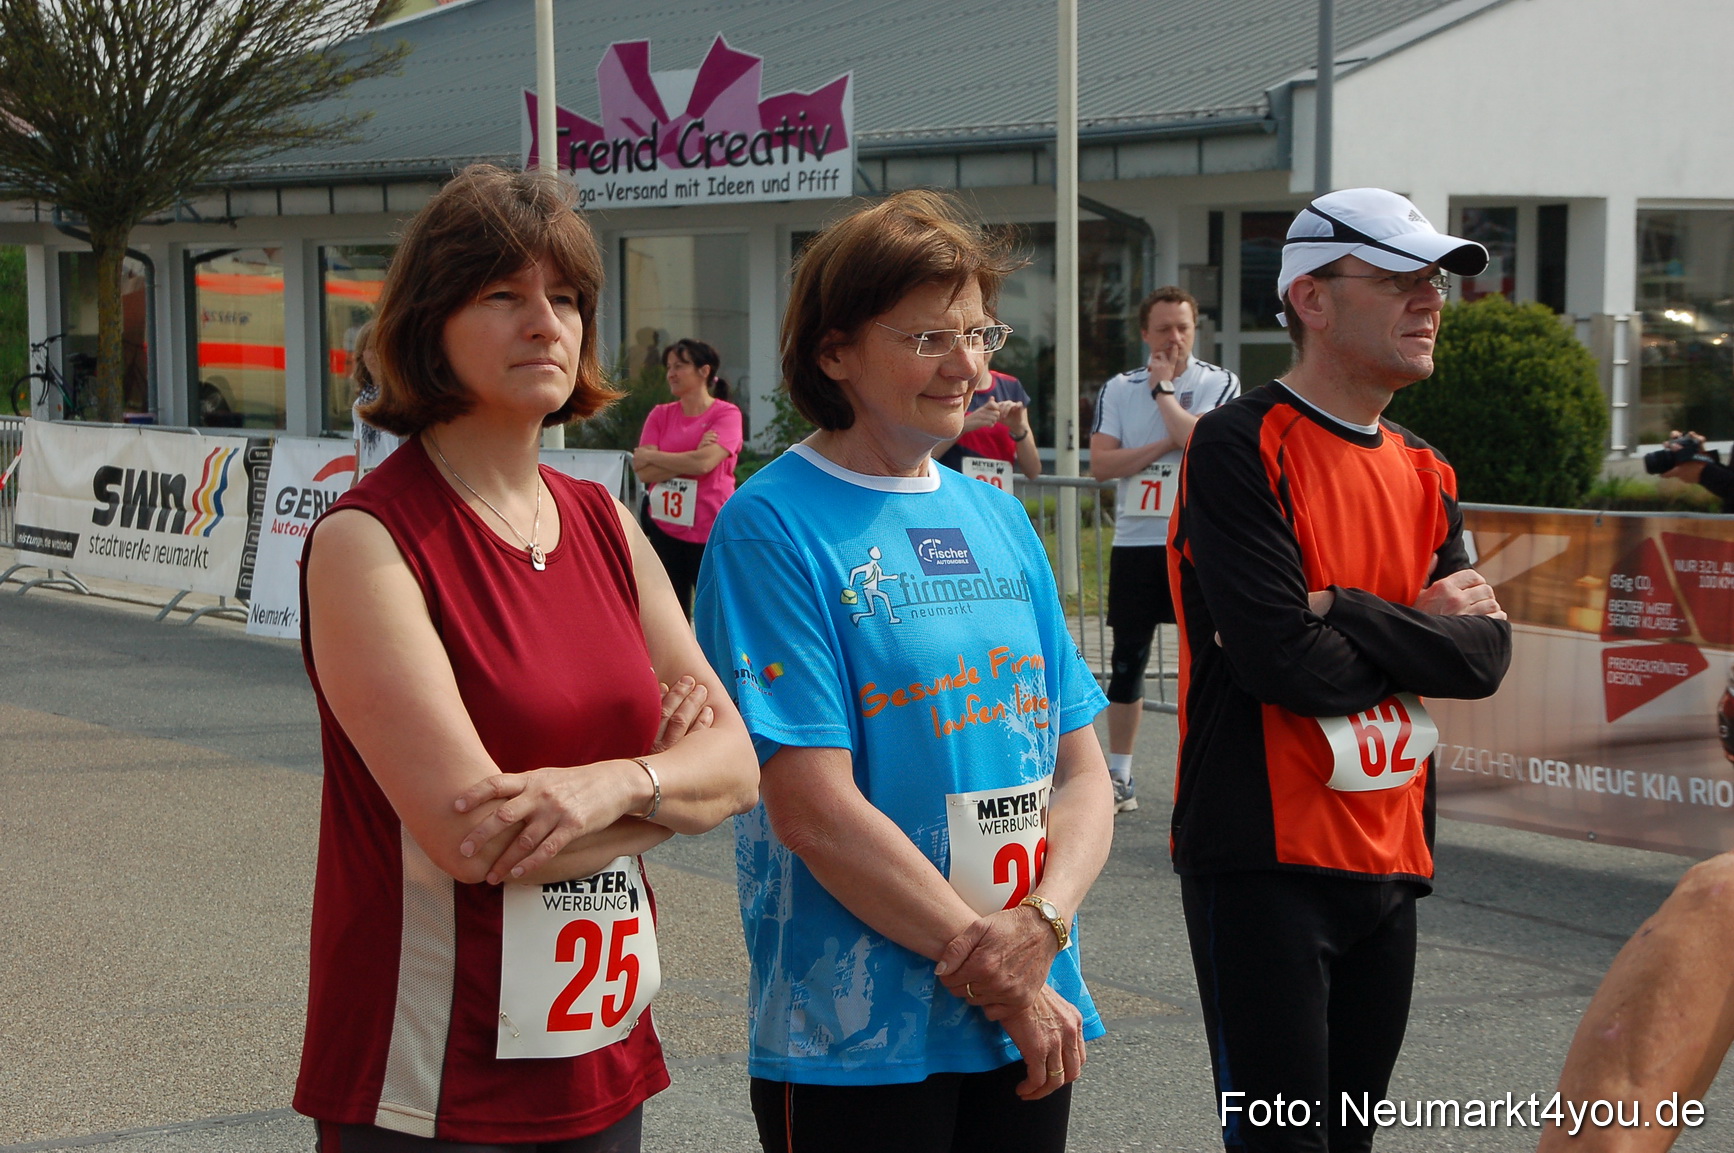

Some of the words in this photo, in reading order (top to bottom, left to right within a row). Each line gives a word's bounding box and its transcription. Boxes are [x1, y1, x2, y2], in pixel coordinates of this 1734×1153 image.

[678, 111, 832, 169] Creativ
[675, 178, 700, 198] mit
[708, 175, 755, 196] Ideen
[762, 172, 790, 194] und
[799, 168, 839, 192] Pfiff
[661, 490, 683, 518] 13
[1140, 480, 1163, 511] 71
[88, 534, 151, 562] stadtwerke
[152, 544, 209, 569] neumarkt
[928, 547, 968, 559] Fischer
[899, 567, 1030, 605] firmenlauf
[910, 603, 973, 619] neumarkt
[859, 654, 981, 718] Gesunde
[930, 693, 1007, 740] laufen
[1346, 695, 1416, 777] 62
[1528, 757, 1572, 788] DER
[1576, 764, 1637, 797] NEUE
[1642, 772, 1684, 803] KIA
[1689, 777, 1733, 808] RIO
[977, 791, 1037, 820] MEYER
[979, 813, 1039, 835] WERBUNG
[543, 895, 628, 911] WERBUNG
[546, 917, 640, 1033] 25
